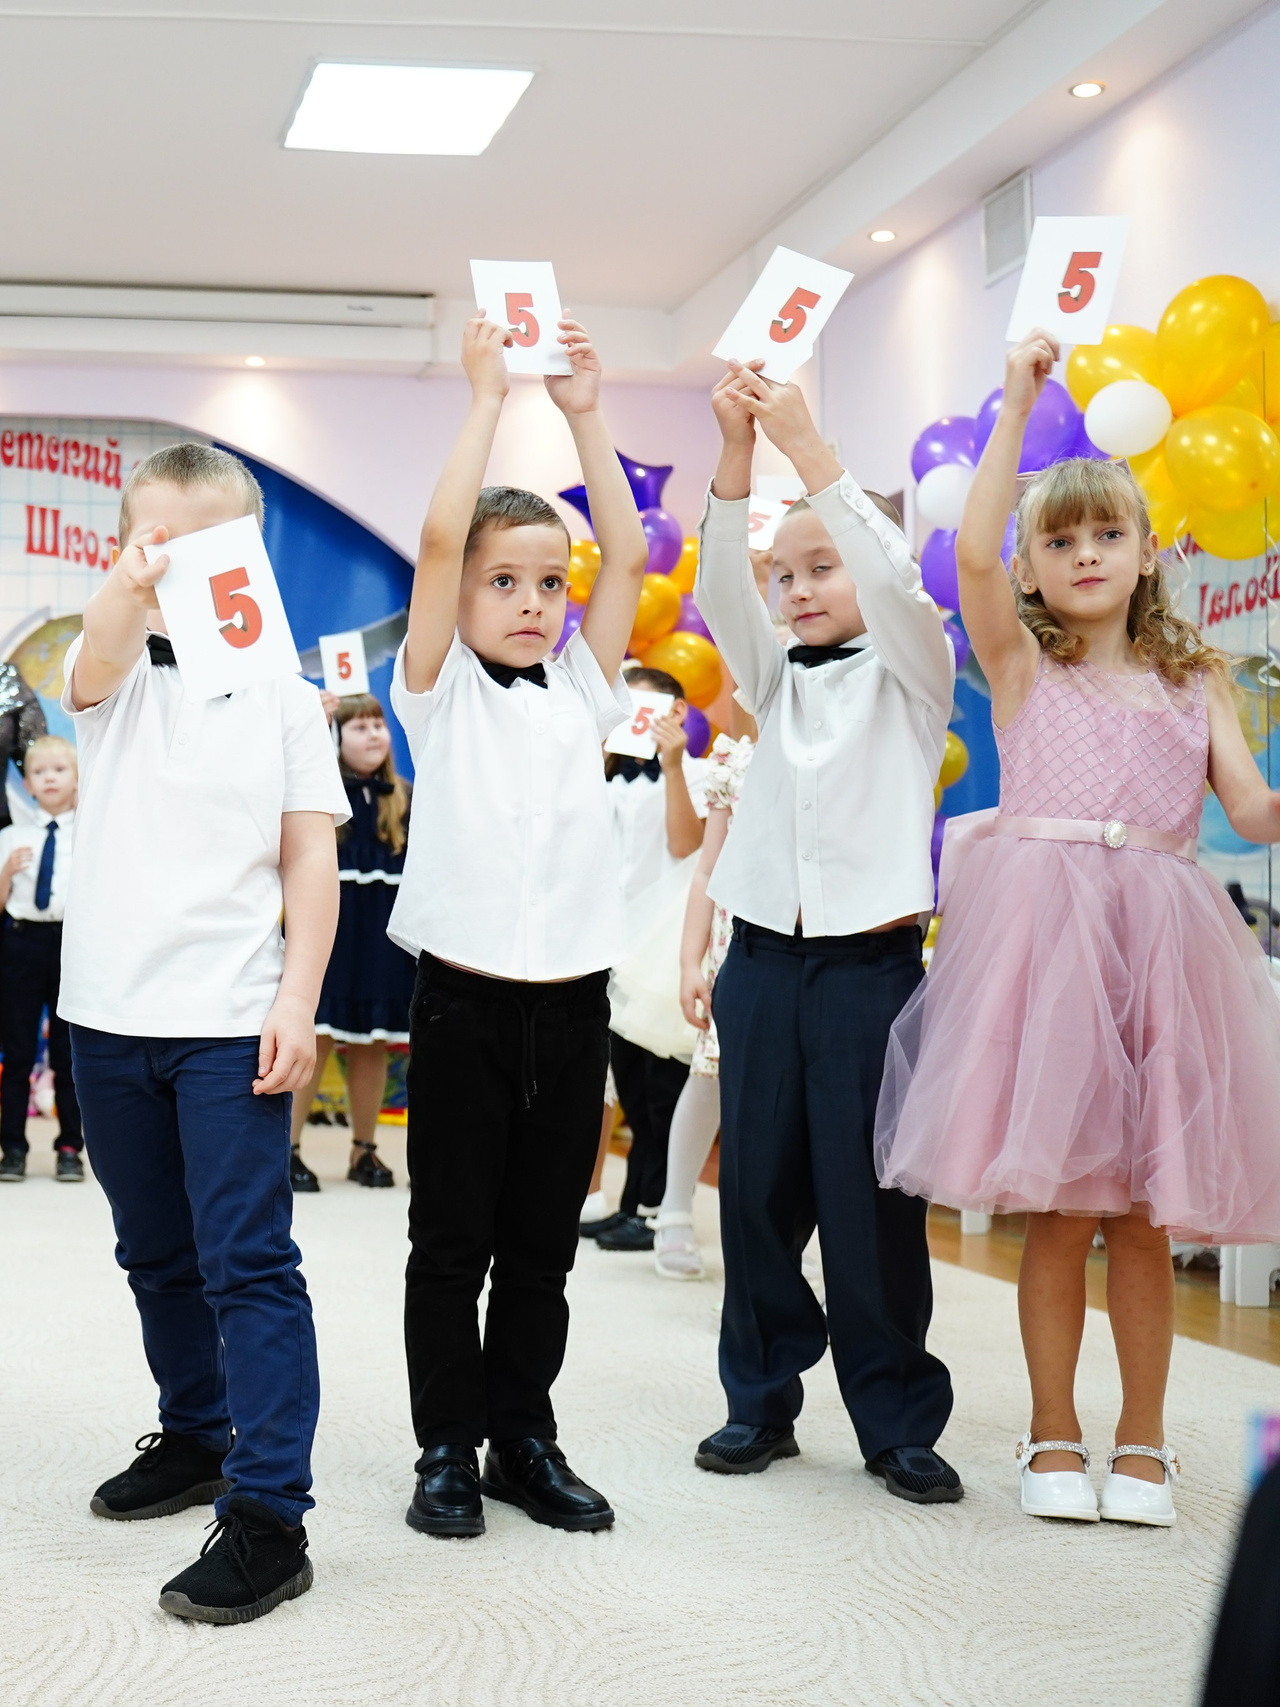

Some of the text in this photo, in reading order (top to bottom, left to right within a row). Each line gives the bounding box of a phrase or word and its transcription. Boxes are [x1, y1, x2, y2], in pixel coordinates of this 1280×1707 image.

[1058, 251, 1102, 313] 5
[505, 293, 540, 347] 5
[769, 287, 821, 343] 5
[209, 566, 263, 649] 5
[336, 651, 353, 681] 5
[631, 706, 655, 736] 5
